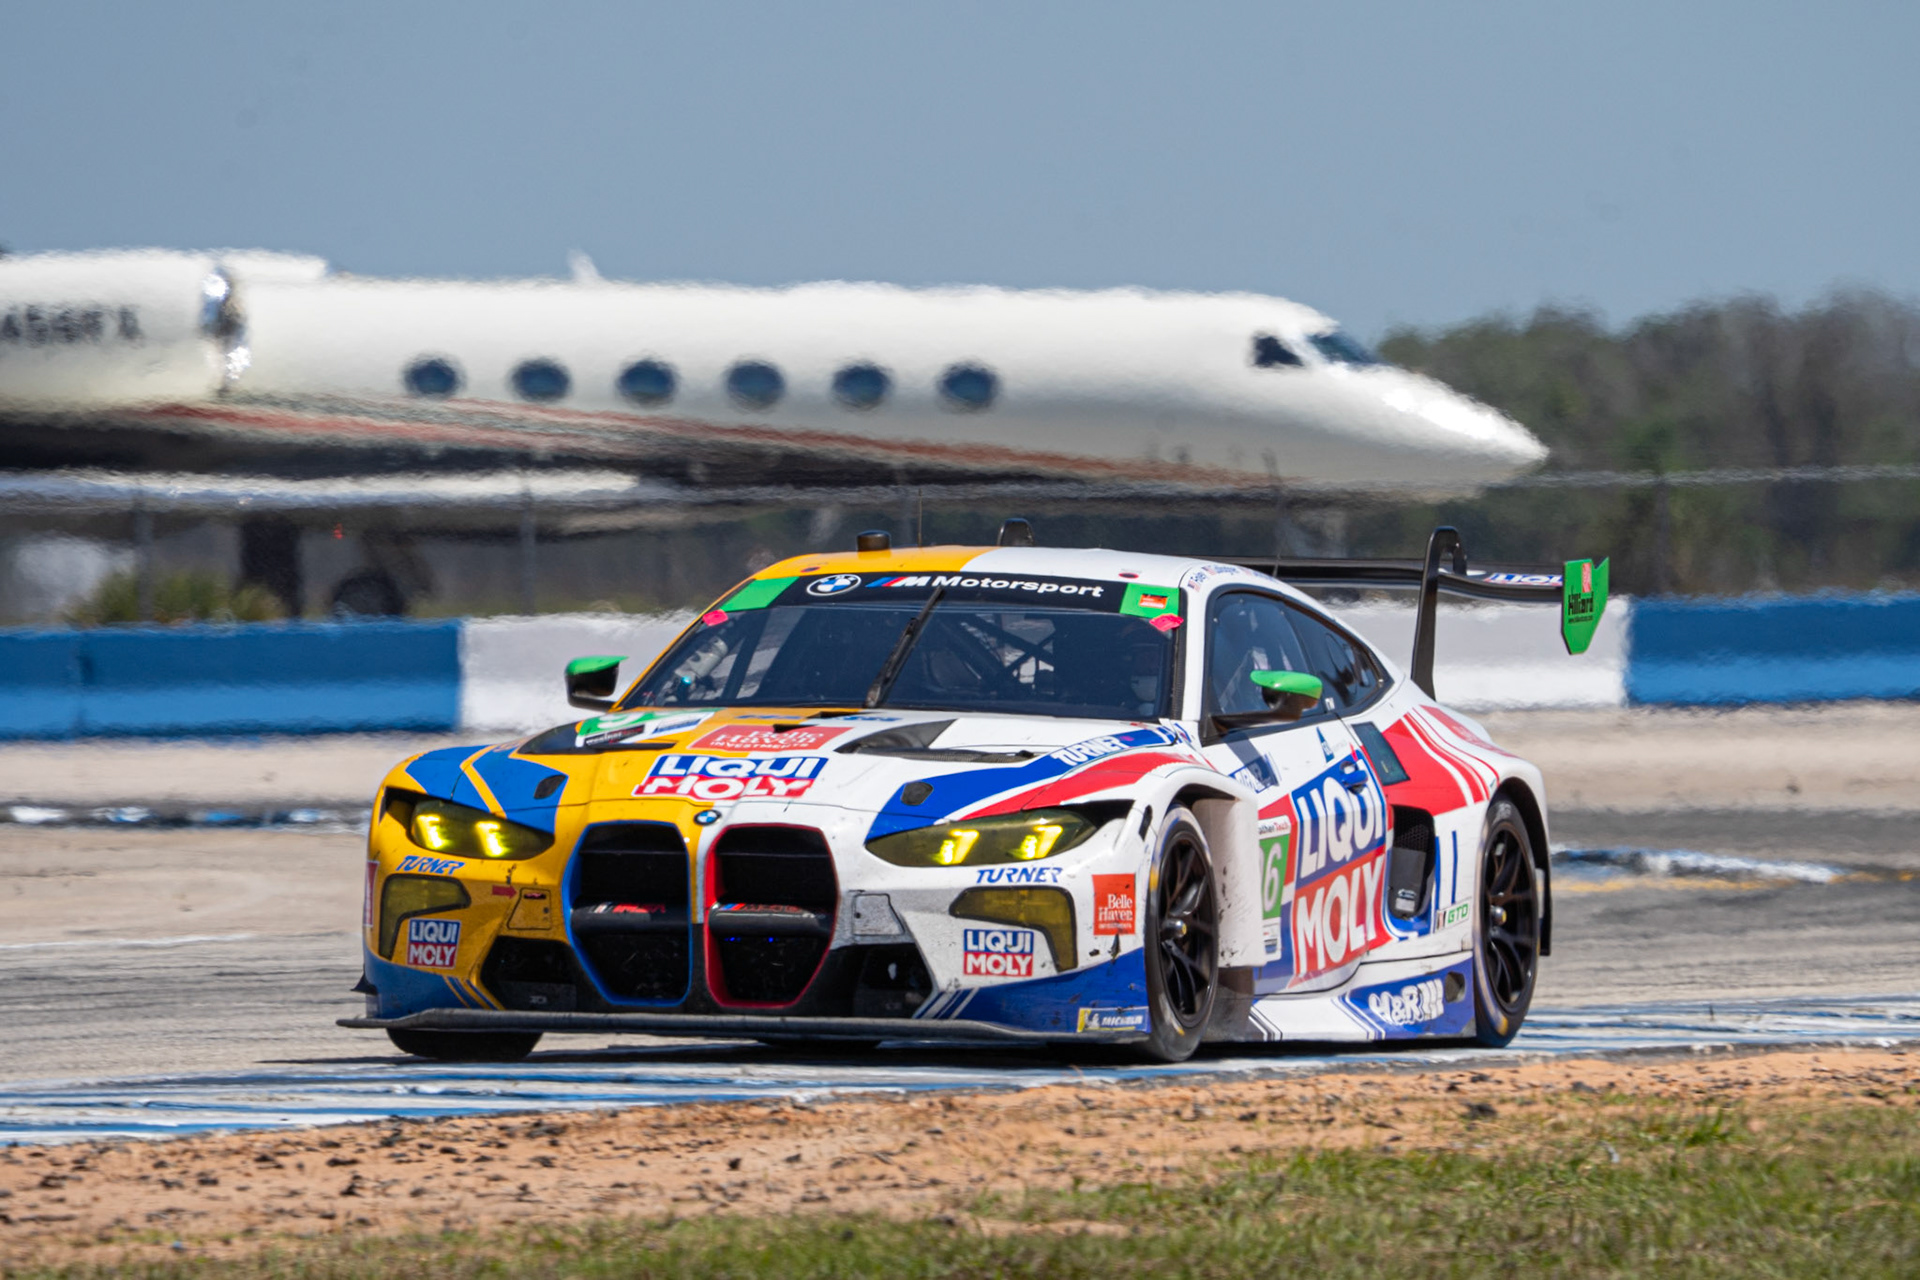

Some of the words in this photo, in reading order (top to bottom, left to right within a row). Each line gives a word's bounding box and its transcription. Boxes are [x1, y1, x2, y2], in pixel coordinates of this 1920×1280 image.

[932, 576, 1104, 597] Motorsport
[1050, 735, 1131, 766] TURNER
[657, 756, 815, 777] LIQUI
[642, 776, 812, 800] MOLY
[1297, 758, 1384, 879] LIQUI
[395, 855, 466, 875] TURNER
[976, 867, 1063, 884] TURNER
[1259, 842, 1282, 913] 6
[1108, 894, 1133, 909] Belle
[1098, 907, 1133, 921] Haven
[1297, 855, 1385, 978] MOLY
[410, 921, 458, 943] LIQUI
[966, 930, 1032, 953] LIQUI
[409, 944, 456, 966] MOLY
[966, 953, 1032, 976] MOLY
[1368, 984, 1425, 1026] H&R
